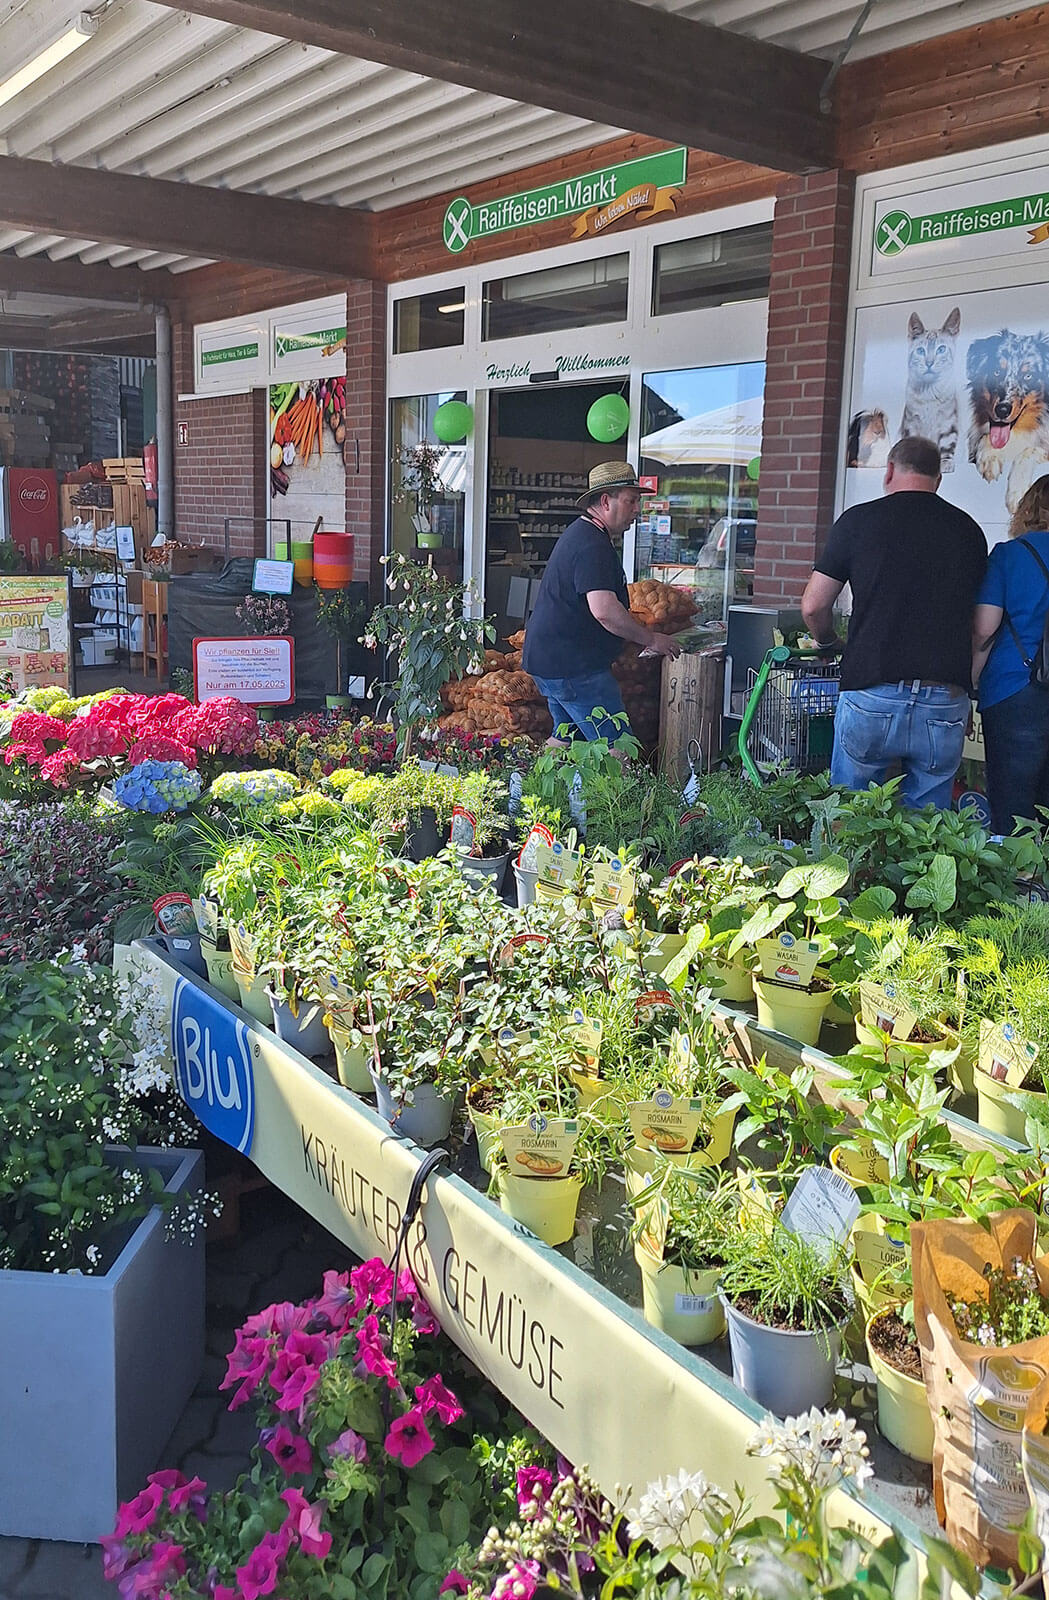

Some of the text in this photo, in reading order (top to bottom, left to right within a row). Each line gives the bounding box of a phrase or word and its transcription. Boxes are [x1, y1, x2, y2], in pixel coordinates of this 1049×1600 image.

[479, 174, 617, 232] Raiffeisen-Markt
[626, 189, 650, 209] Nähe!
[486, 353, 631, 383] Herzlich Willkommen
[204, 648, 217, 656] Wir
[219, 647, 250, 656] pflanzen
[251, 647, 262, 655] für
[205, 681, 222, 689] Nur
[240, 680, 286, 689] 17.05.2025
[776, 950, 799, 962] WASABI
[181, 1016, 242, 1111] Blu
[647, 1113, 683, 1124] ROSMARIN
[521, 1138, 557, 1149] ROSMARIN
[301, 1124, 401, 1252] KRÄUTER
[443, 1247, 565, 1410] GEMÜSE
